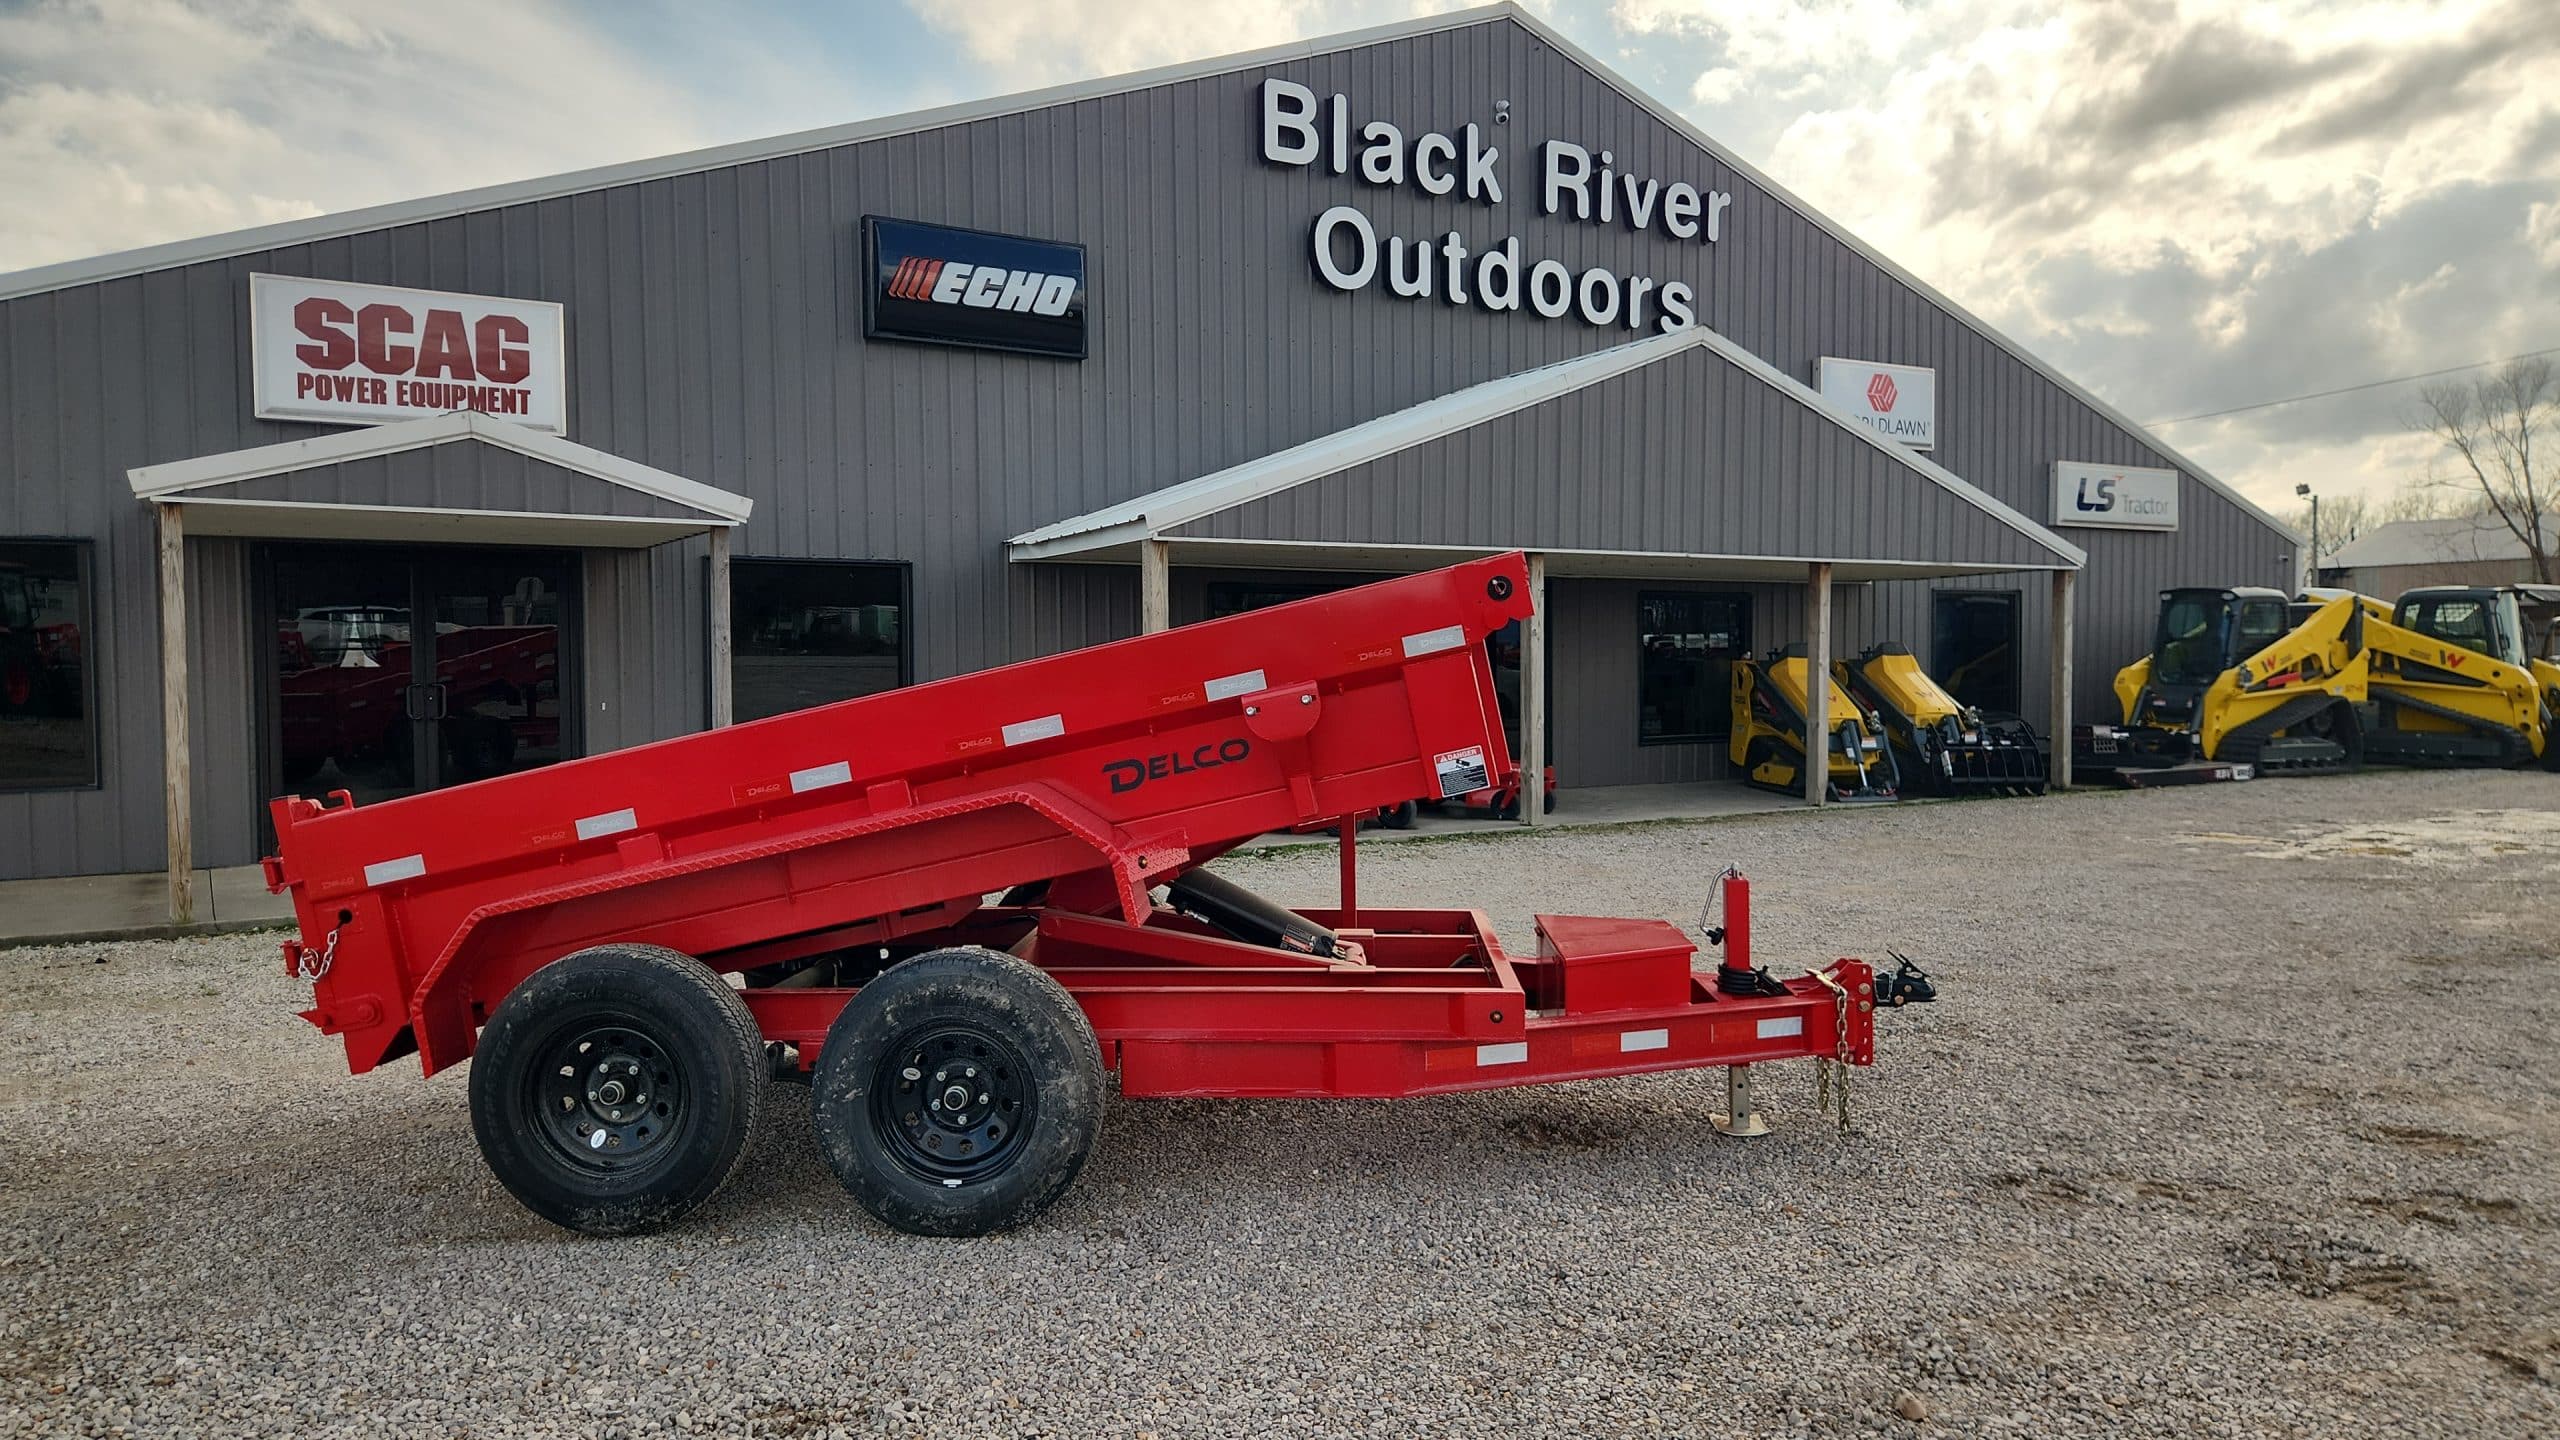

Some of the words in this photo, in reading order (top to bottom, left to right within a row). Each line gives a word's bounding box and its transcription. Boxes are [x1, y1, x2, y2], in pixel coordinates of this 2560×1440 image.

[1263, 77, 1503, 204] Black
[1545, 139, 1731, 243] River
[931, 260, 1077, 317] ECHO
[1314, 206, 1695, 334] Outdoors
[294, 297, 531, 385] SCAG
[296, 372, 388, 406] POWER
[396, 379, 532, 415] EQUIPMENT
[2076, 477, 2116, 512] LS
[2120, 494, 2170, 514] Tractor
[1358, 647, 1393, 661] DELCO
[1103, 738, 1250, 794] DELCO
[1447, 748, 1477, 761] DANGER
